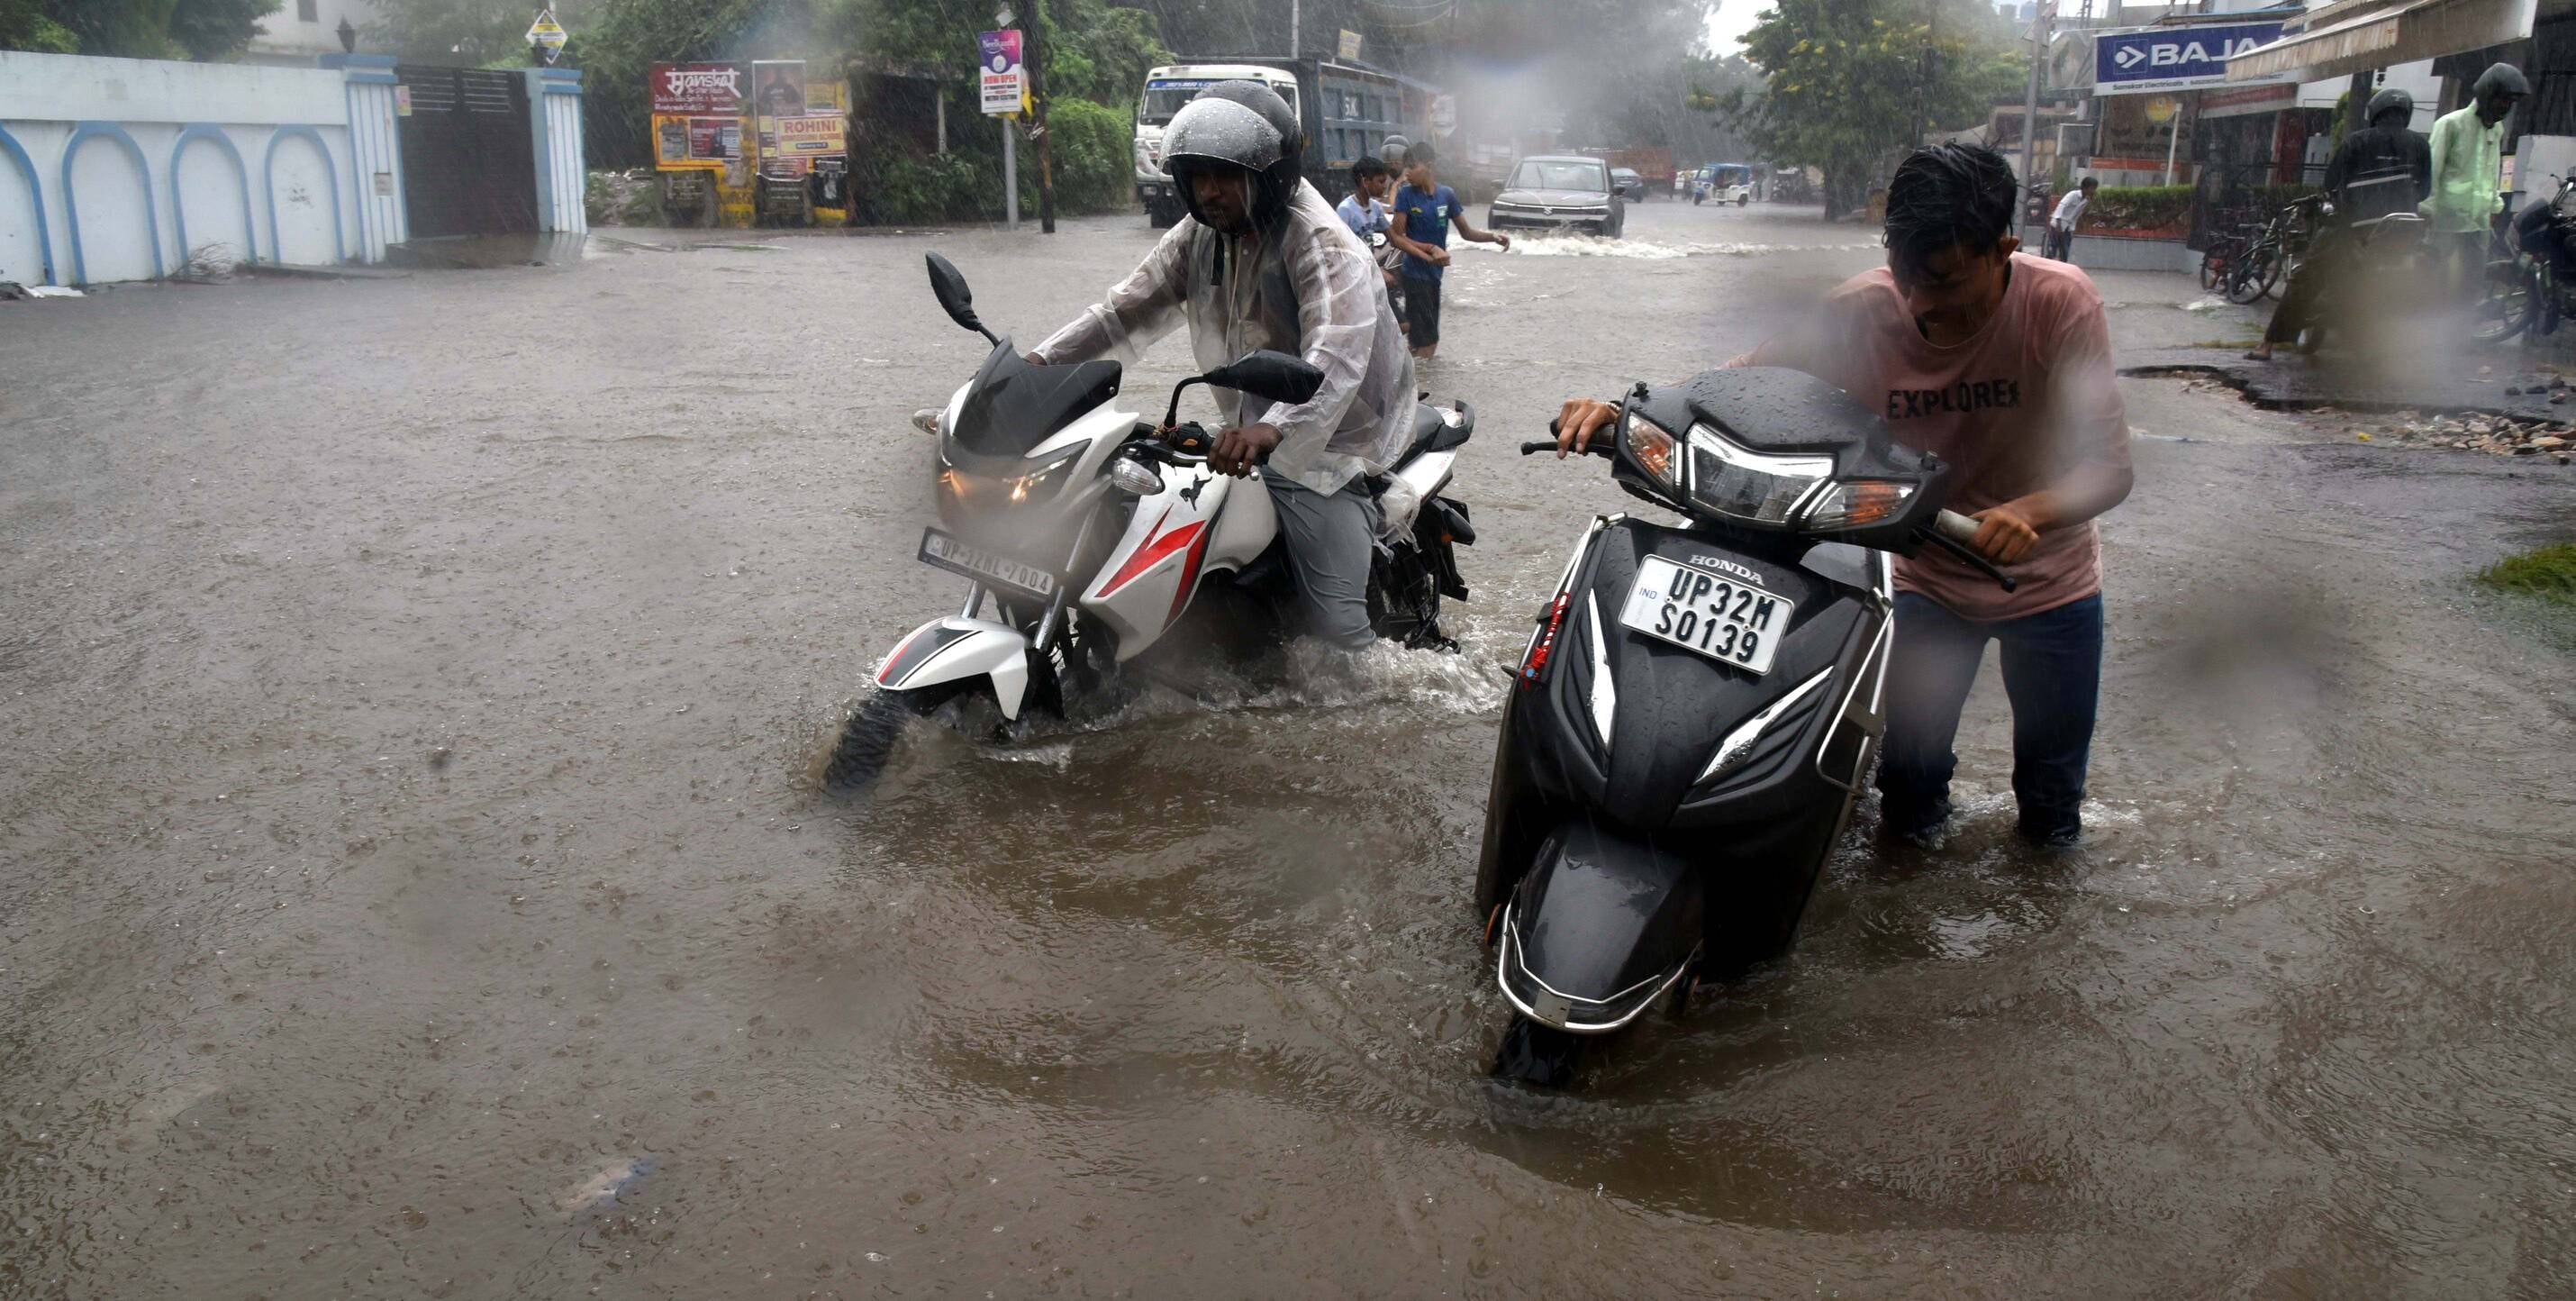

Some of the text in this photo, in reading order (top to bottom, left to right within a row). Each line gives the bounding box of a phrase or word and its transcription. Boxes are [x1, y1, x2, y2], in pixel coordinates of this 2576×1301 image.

[2150, 35, 2287, 67] BAJA
[785, 121, 836, 133] ROHINI
[1689, 554, 1765, 587] HONDA
[1638, 587, 1658, 601] IND
[1669, 569, 1775, 631] UP32M
[1655, 603, 1758, 663] S0139
